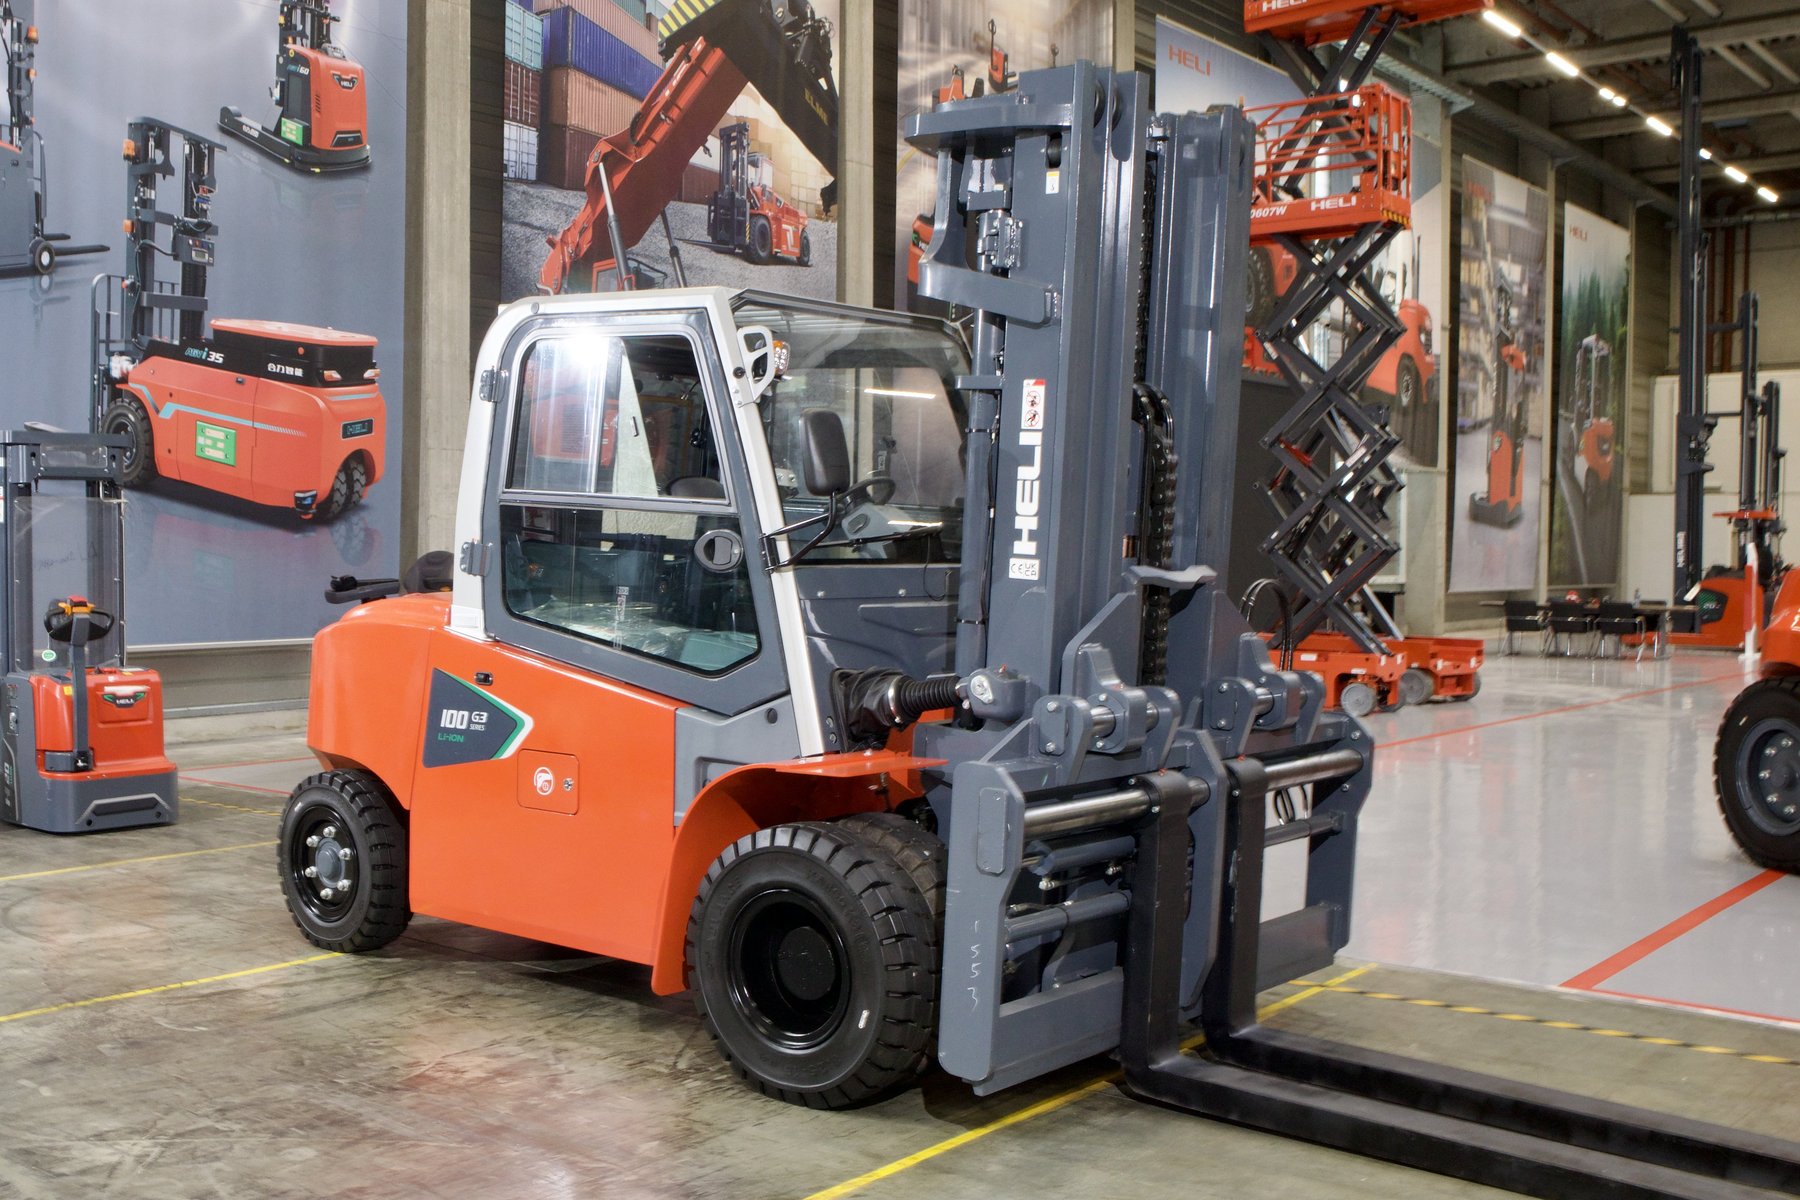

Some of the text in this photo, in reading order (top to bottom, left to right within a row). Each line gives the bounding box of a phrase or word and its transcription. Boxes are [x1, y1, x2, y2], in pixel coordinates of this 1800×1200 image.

[1262, 0, 1307, 13] HEL
[1169, 44, 1211, 77] HELI
[1311, 196, 1356, 212] HELI
[1013, 431, 1043, 555] HELI
[440, 709, 488, 730] 100 G3
[469, 723, 485, 731] SERIES
